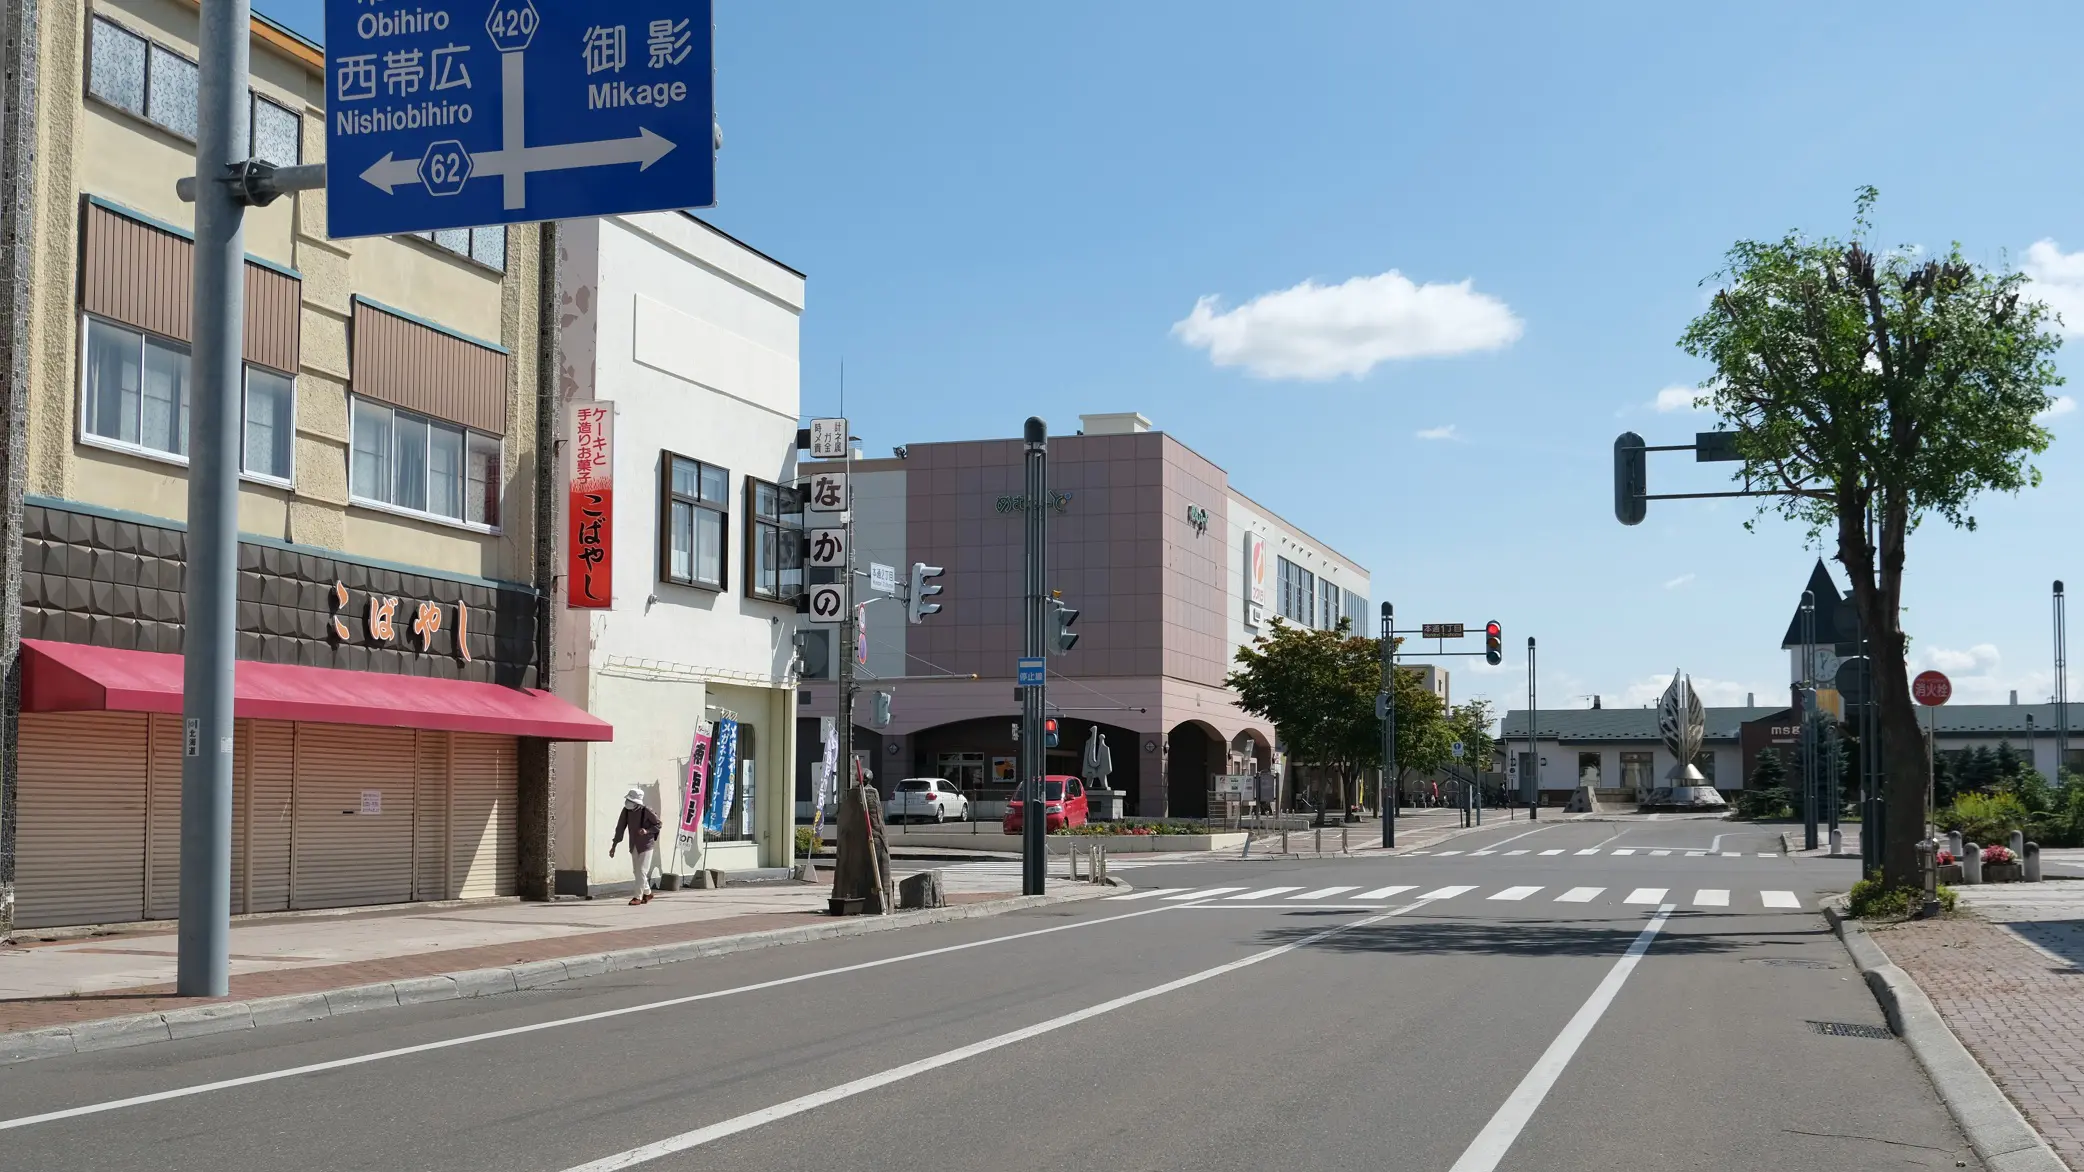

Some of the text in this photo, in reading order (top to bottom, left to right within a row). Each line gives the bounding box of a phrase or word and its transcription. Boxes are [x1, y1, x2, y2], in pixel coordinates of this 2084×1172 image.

[357, 9, 449, 39] Obihiro
[491, 7, 533, 37] 420
[582, 17, 692, 75] 御影
[336, 42, 472, 101] 西帯広
[588, 80, 687, 110] Mikage
[336, 101, 472, 135] Nishiobihiro
[431, 152, 460, 183] 62
[577, 408, 592, 485] 手造りお菓子
[592, 407, 607, 466] ケーキと
[578, 494, 607, 601] こばやし
[813, 476, 842, 617] なかの
[333, 579, 472, 662] こばやし
[1915, 683, 1949, 697] 消火栓
